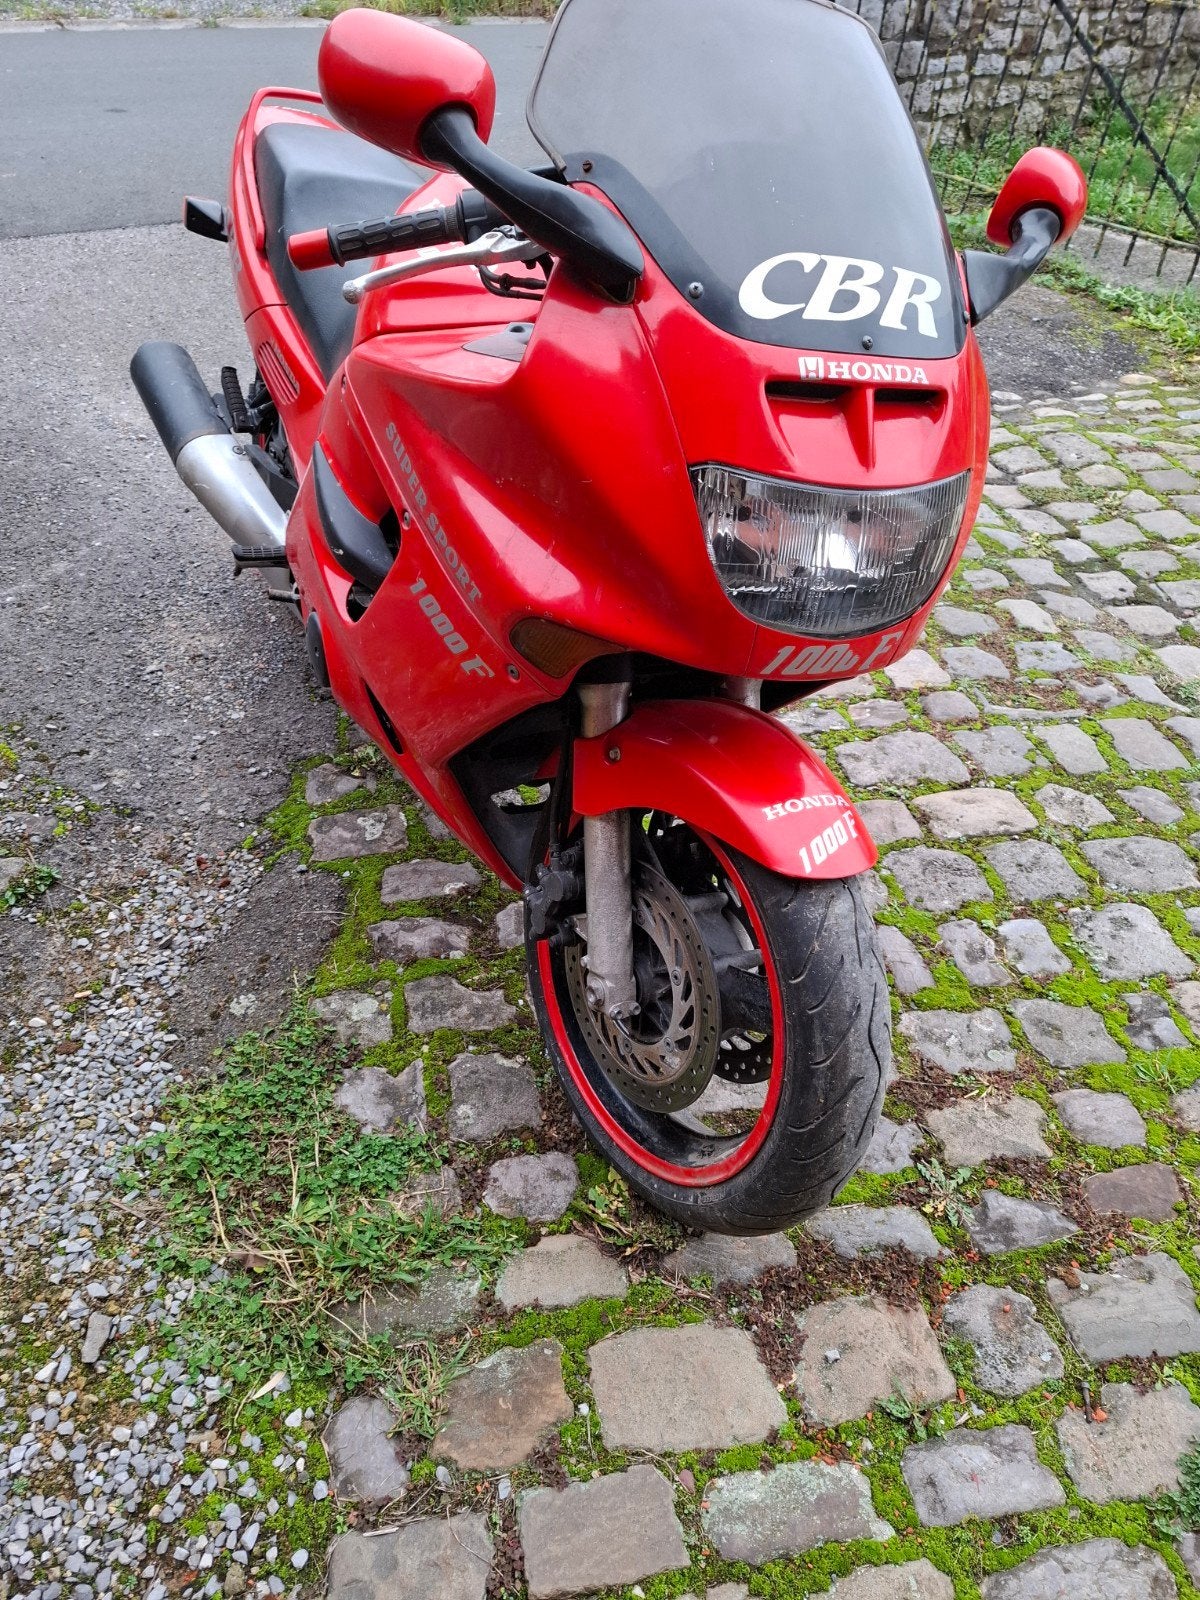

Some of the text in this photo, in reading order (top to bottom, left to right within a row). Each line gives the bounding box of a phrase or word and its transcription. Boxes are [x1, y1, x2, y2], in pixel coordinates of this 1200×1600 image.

[738, 252, 942, 338] CBR
[827, 361, 929, 384] HONDA
[385, 422, 482, 602] SUPER SPORT
[409, 577, 496, 679] 1000 F
[761, 794, 850, 821] HONDA
